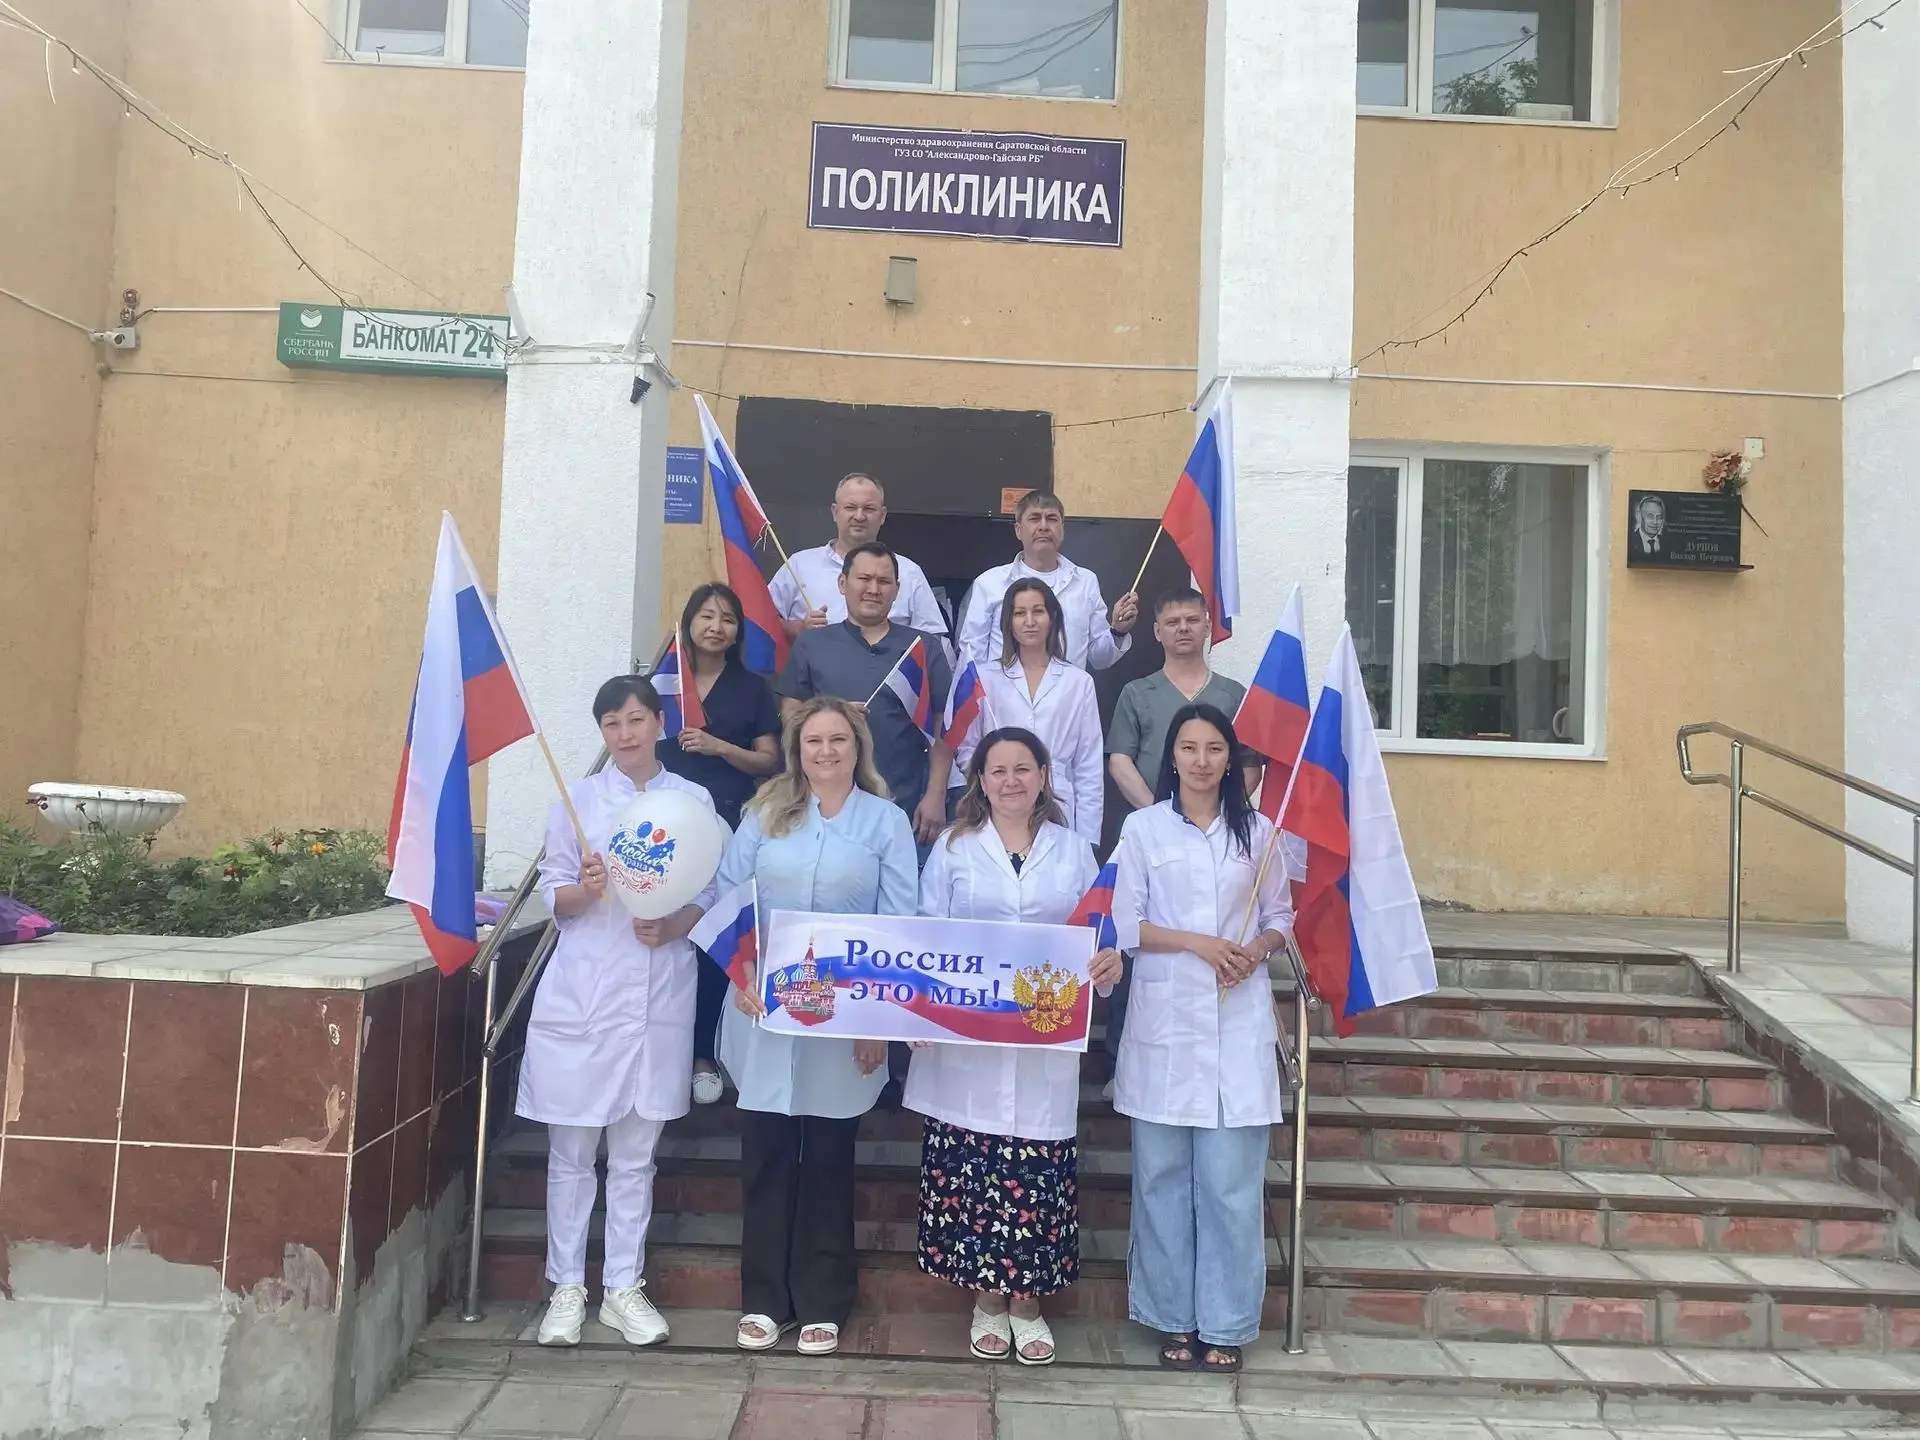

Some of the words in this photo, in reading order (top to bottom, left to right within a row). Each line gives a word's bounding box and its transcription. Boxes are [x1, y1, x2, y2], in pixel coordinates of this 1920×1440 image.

[852, 133, 915, 147] Министерство
[916, 138, 993, 151] здравоохранения
[995, 140, 1050, 153] Саратовской
[1051, 145, 1087, 156] области
[894, 149, 911, 158] ГУЗ
[912, 150, 924, 159] СО
[925, 150, 1027, 164] "Александрово-Гайская
[1028, 154, 1044, 164] РБ"
[822, 166, 1112, 225] ПОЛИКЛИНИКА
[283, 337, 335, 349] СБЕРБАНК
[288, 346, 329, 358] РОССИИ
[353, 323, 461, 354] БАНКОМАТ
[462, 324, 495, 360] 24
[843, 939, 985, 975] Россия
[850, 979, 914, 1003] это
[929, 979, 1000, 1008] мы!
